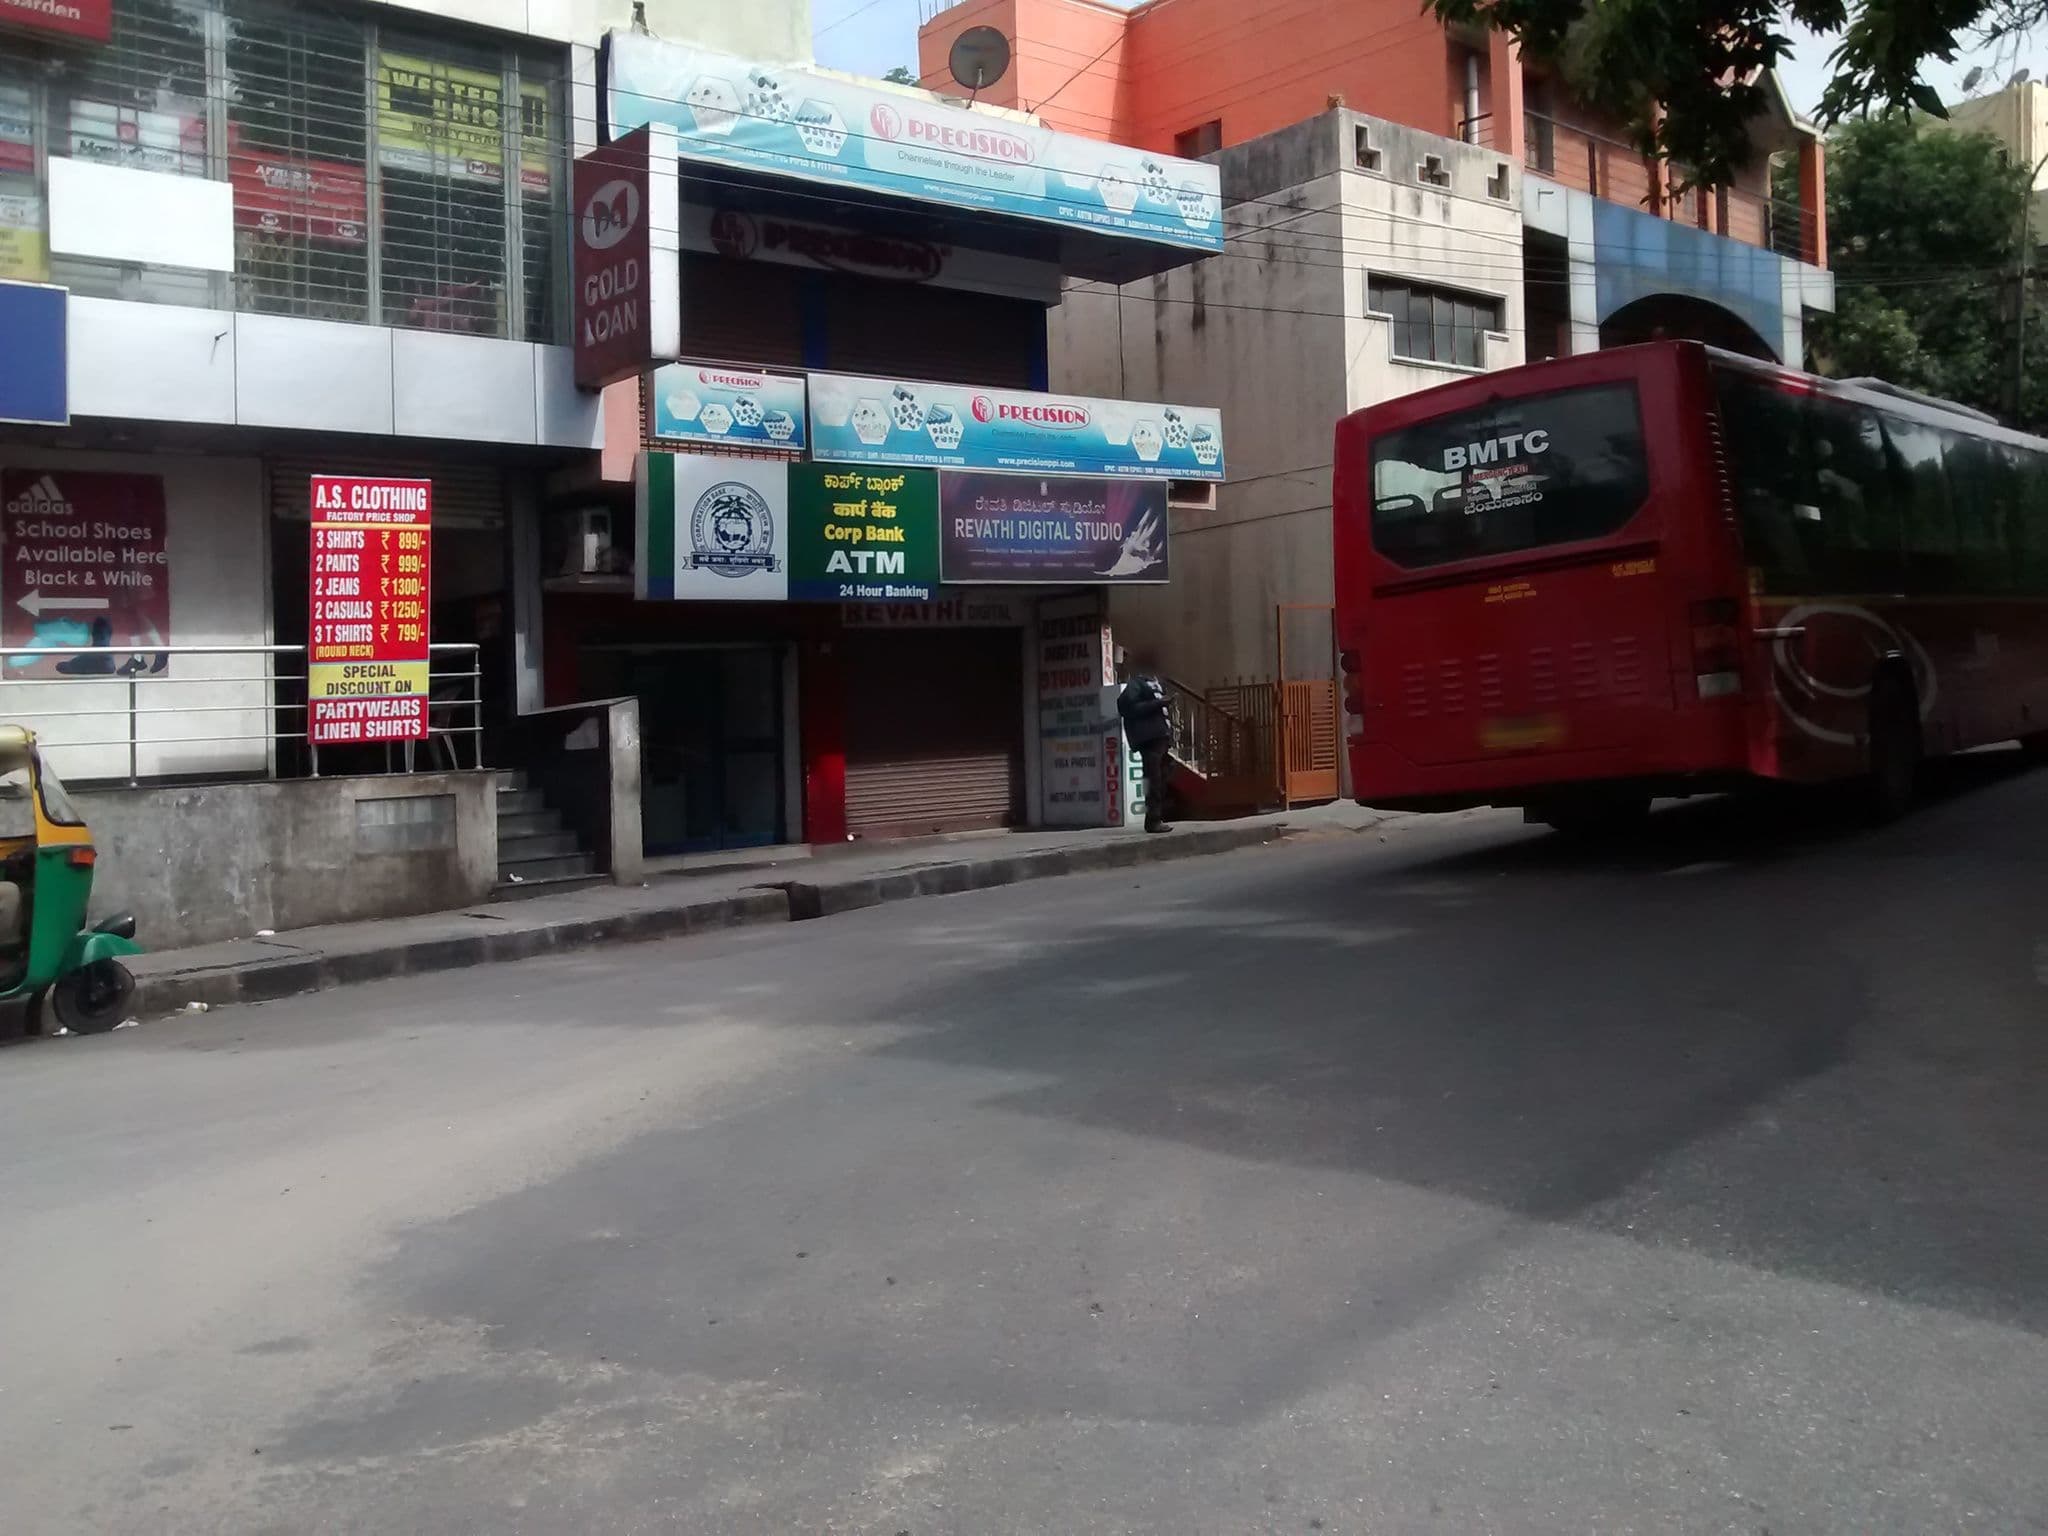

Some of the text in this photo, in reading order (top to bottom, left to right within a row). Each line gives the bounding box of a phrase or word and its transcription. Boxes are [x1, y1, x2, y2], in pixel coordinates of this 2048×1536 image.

[4, 0, 80, 20] arden
[908, 119, 1029, 161] PRECISION
[944, 160, 974, 175] through
[975, 165, 987, 177] the
[989, 169, 1015, 182] Leader
[584, 258, 639, 306] GOLD
[712, 375, 760, 387] PRECISION
[998, 404, 1086, 424] PRECISION
[1444, 430, 1550, 471] BMTC
[316, 485, 427, 510] A.S. CLOTHING
[7, 501, 73, 515] adidas
[327, 511, 416, 522] FACTORY PRICE SHOP
[16, 520, 152, 540] School Shoes
[824, 524, 905, 544] Corp Bank
[955, 518, 1123, 541] REVATHI DIGITAL STUDIO
[316, 531, 324, 548] 3
[327, 531, 365, 549] SHIRTS
[398, 532, 426, 551] 899/-
[16, 546, 168, 564] Available Here
[316, 554, 324, 572] 2
[326, 554, 359, 572] PANTS
[398, 555, 426, 574] 999/-
[825, 550, 905, 574] ATM
[25, 570, 153, 586] Black & White
[315, 577, 323, 596] 2
[326, 578, 360, 596] JEANS
[840, 585, 929, 600] 24 Hour Banking
[315, 601, 322, 619] 2
[325, 601, 373, 619] CASUALS
[315, 625, 322, 643] 3
[325, 625, 333, 643] T
[335, 624, 373, 643] SHIRTS
[398, 624, 425, 642] 799/-
[316, 645, 374, 660] (ROUND NECK)
[343, 665, 396, 678] SPECIAL
[326, 680, 412, 695] DISCOUNT ON
[316, 700, 420, 720] PARTYWEARS
[315, 719, 421, 740] LINEN SHIRTS
[1106, 737, 1120, 823] STUDIO
